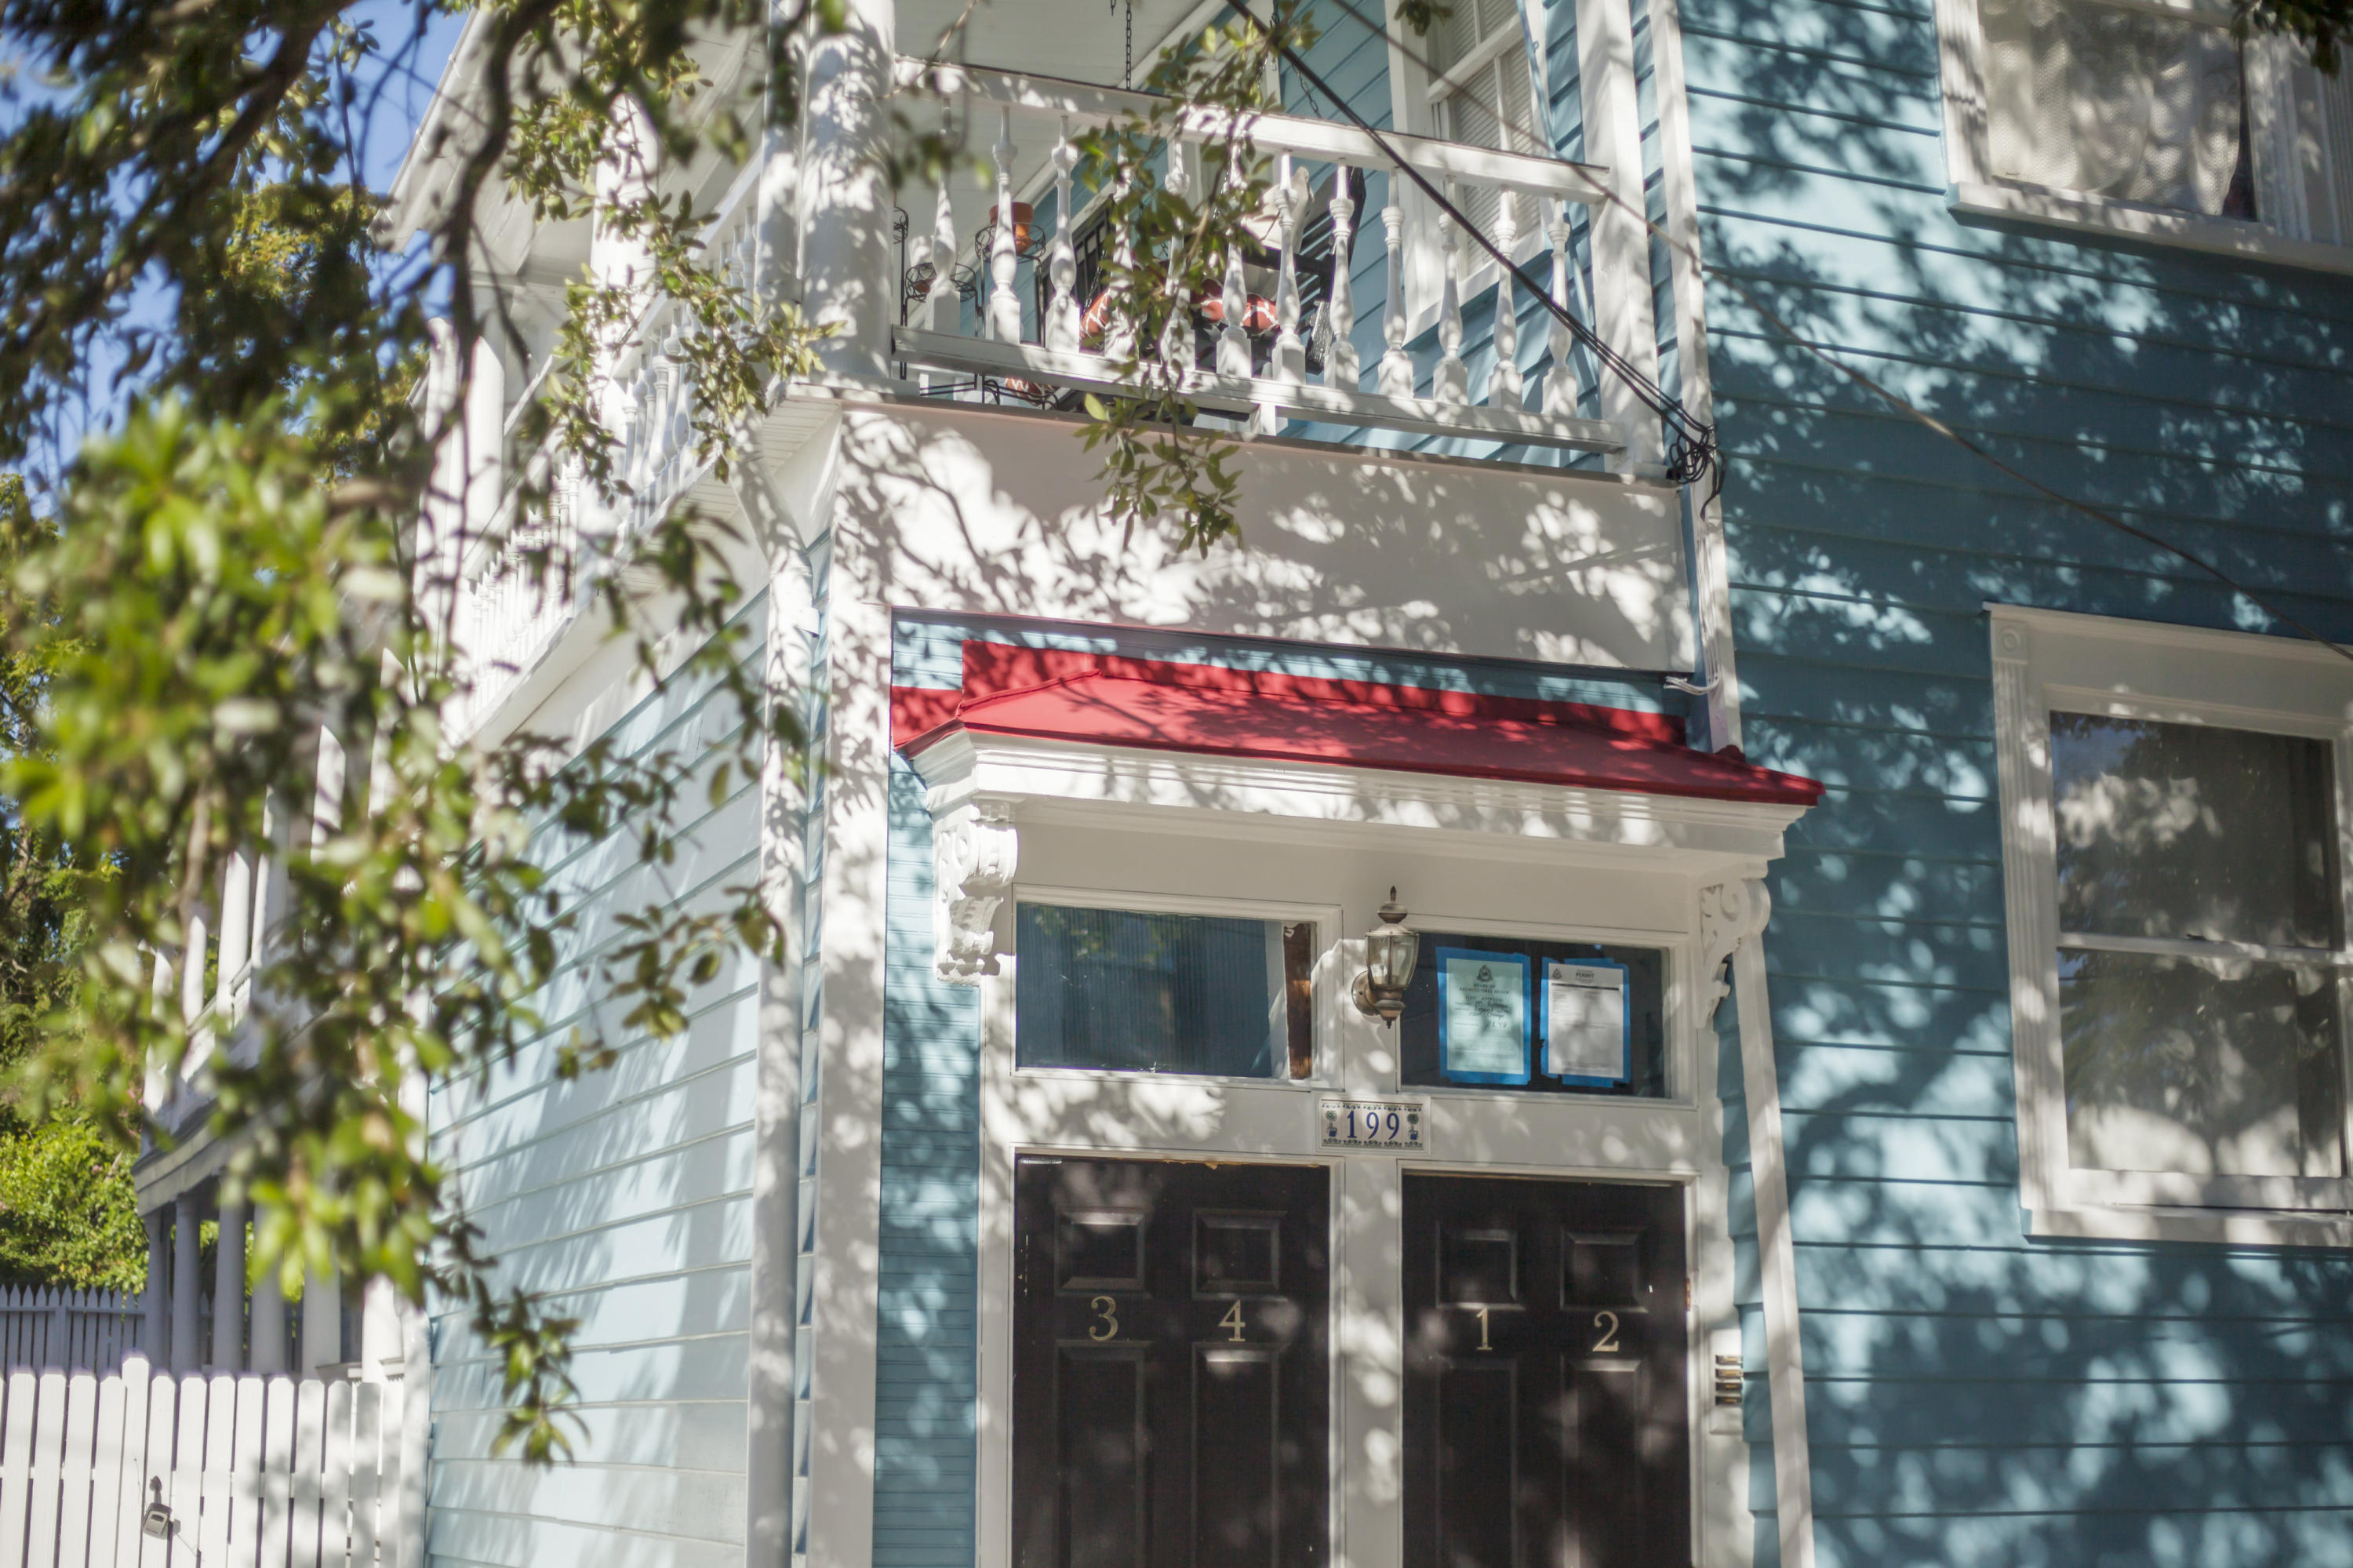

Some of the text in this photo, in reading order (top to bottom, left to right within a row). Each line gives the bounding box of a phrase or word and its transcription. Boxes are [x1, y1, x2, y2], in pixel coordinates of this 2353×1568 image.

[1347, 1110, 1400, 1140] 199
[1089, 1295, 1246, 1341] 3 4
[1476, 1308, 1620, 1352] 1 2
